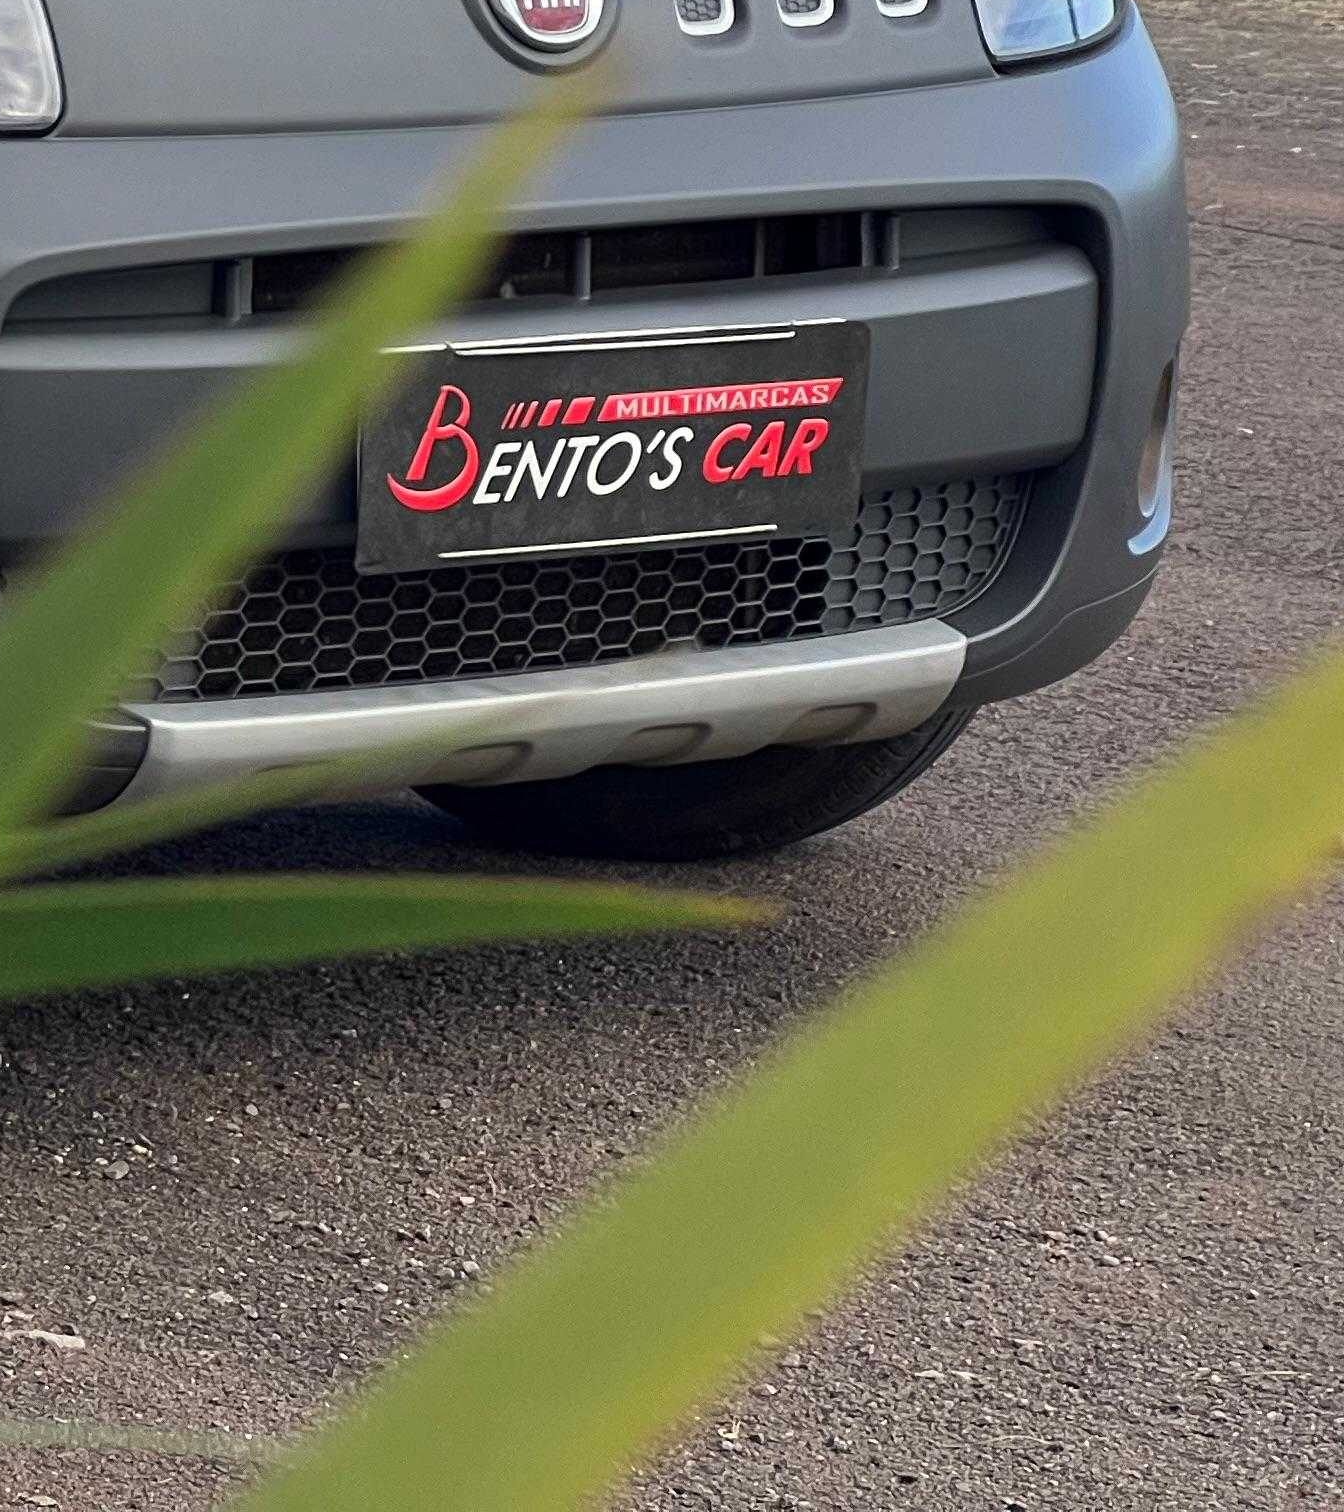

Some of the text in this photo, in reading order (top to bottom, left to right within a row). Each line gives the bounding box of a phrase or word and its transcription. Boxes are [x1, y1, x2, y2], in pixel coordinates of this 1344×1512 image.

[615, 384, 830, 420] MULTIMARCAS
[387, 385, 829, 512] BENTO'S CAR
